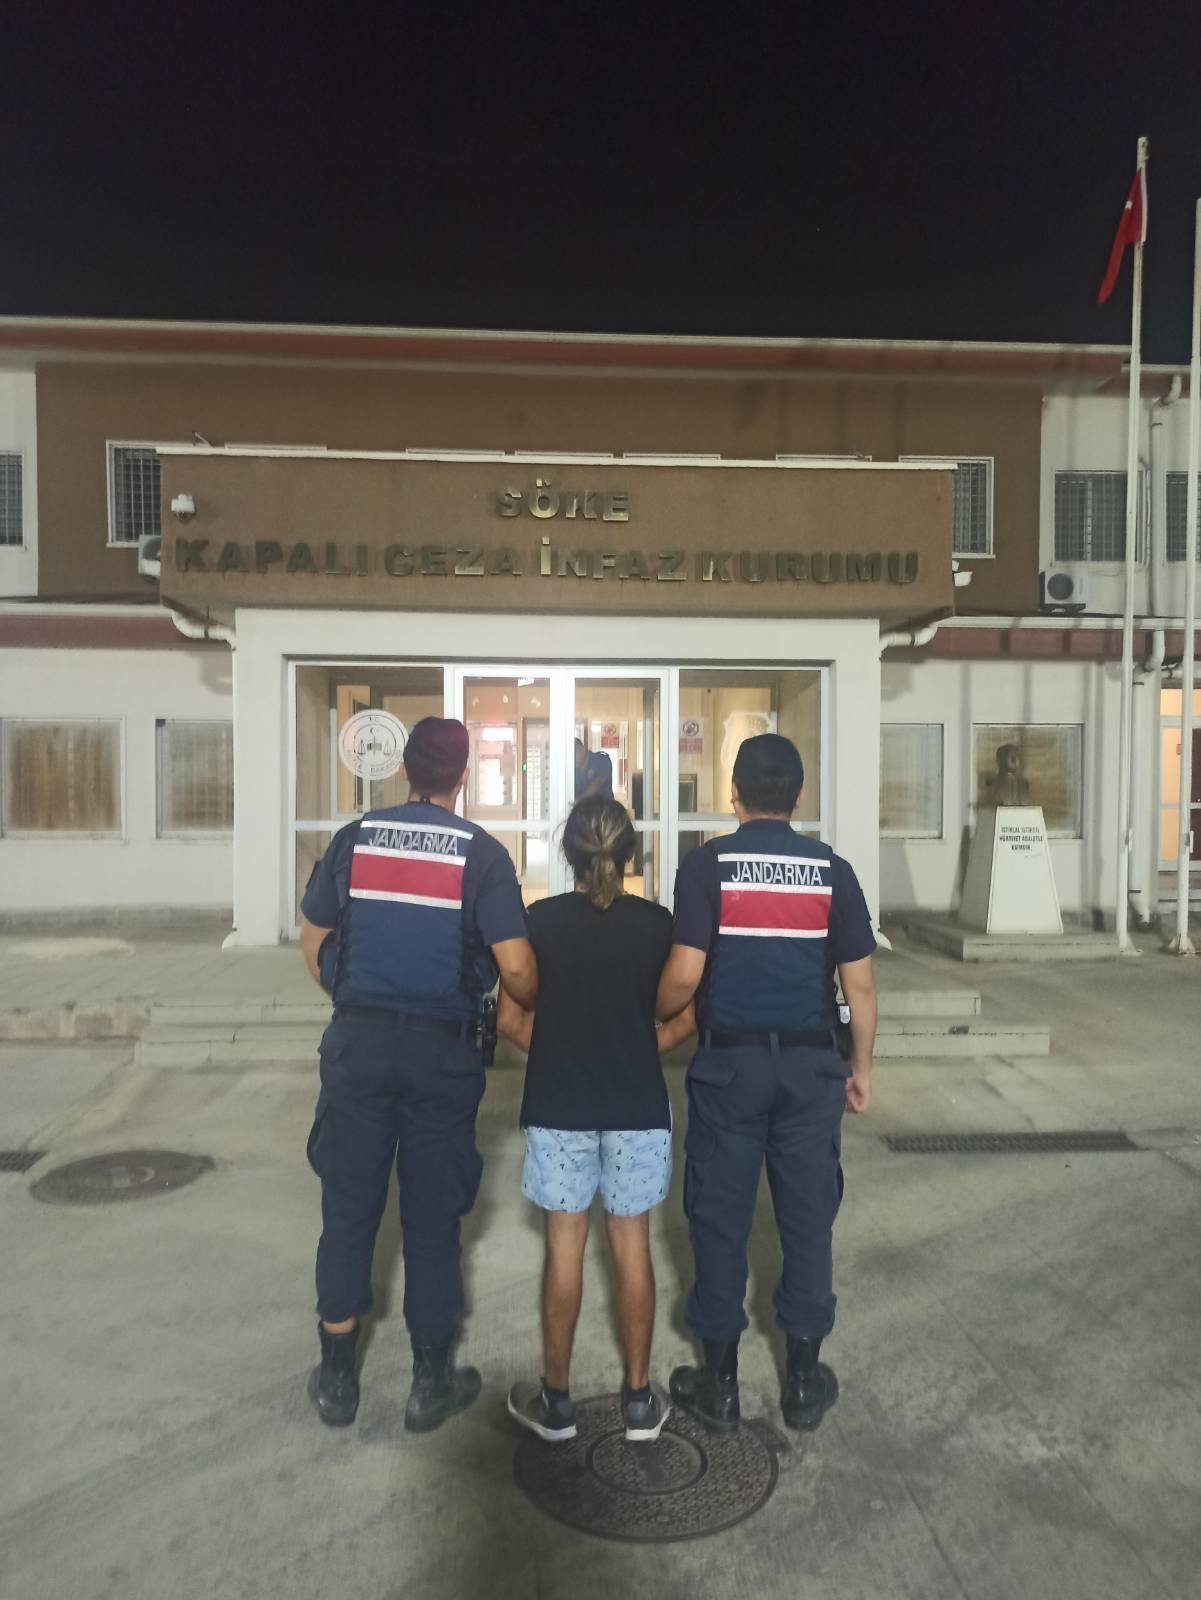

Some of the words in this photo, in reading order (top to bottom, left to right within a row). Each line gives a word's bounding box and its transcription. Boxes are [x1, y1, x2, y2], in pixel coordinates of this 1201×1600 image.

[498, 478, 630, 522] SÖKE
[175, 538, 369, 575] KAPALI
[384, 543, 524, 577] CEZA
[540, 536, 688, 582] İNFAZ
[701, 551, 920, 584] KURUMU
[368, 828, 458, 856] JANDARMA
[731, 861, 823, 886] JANDARMA
